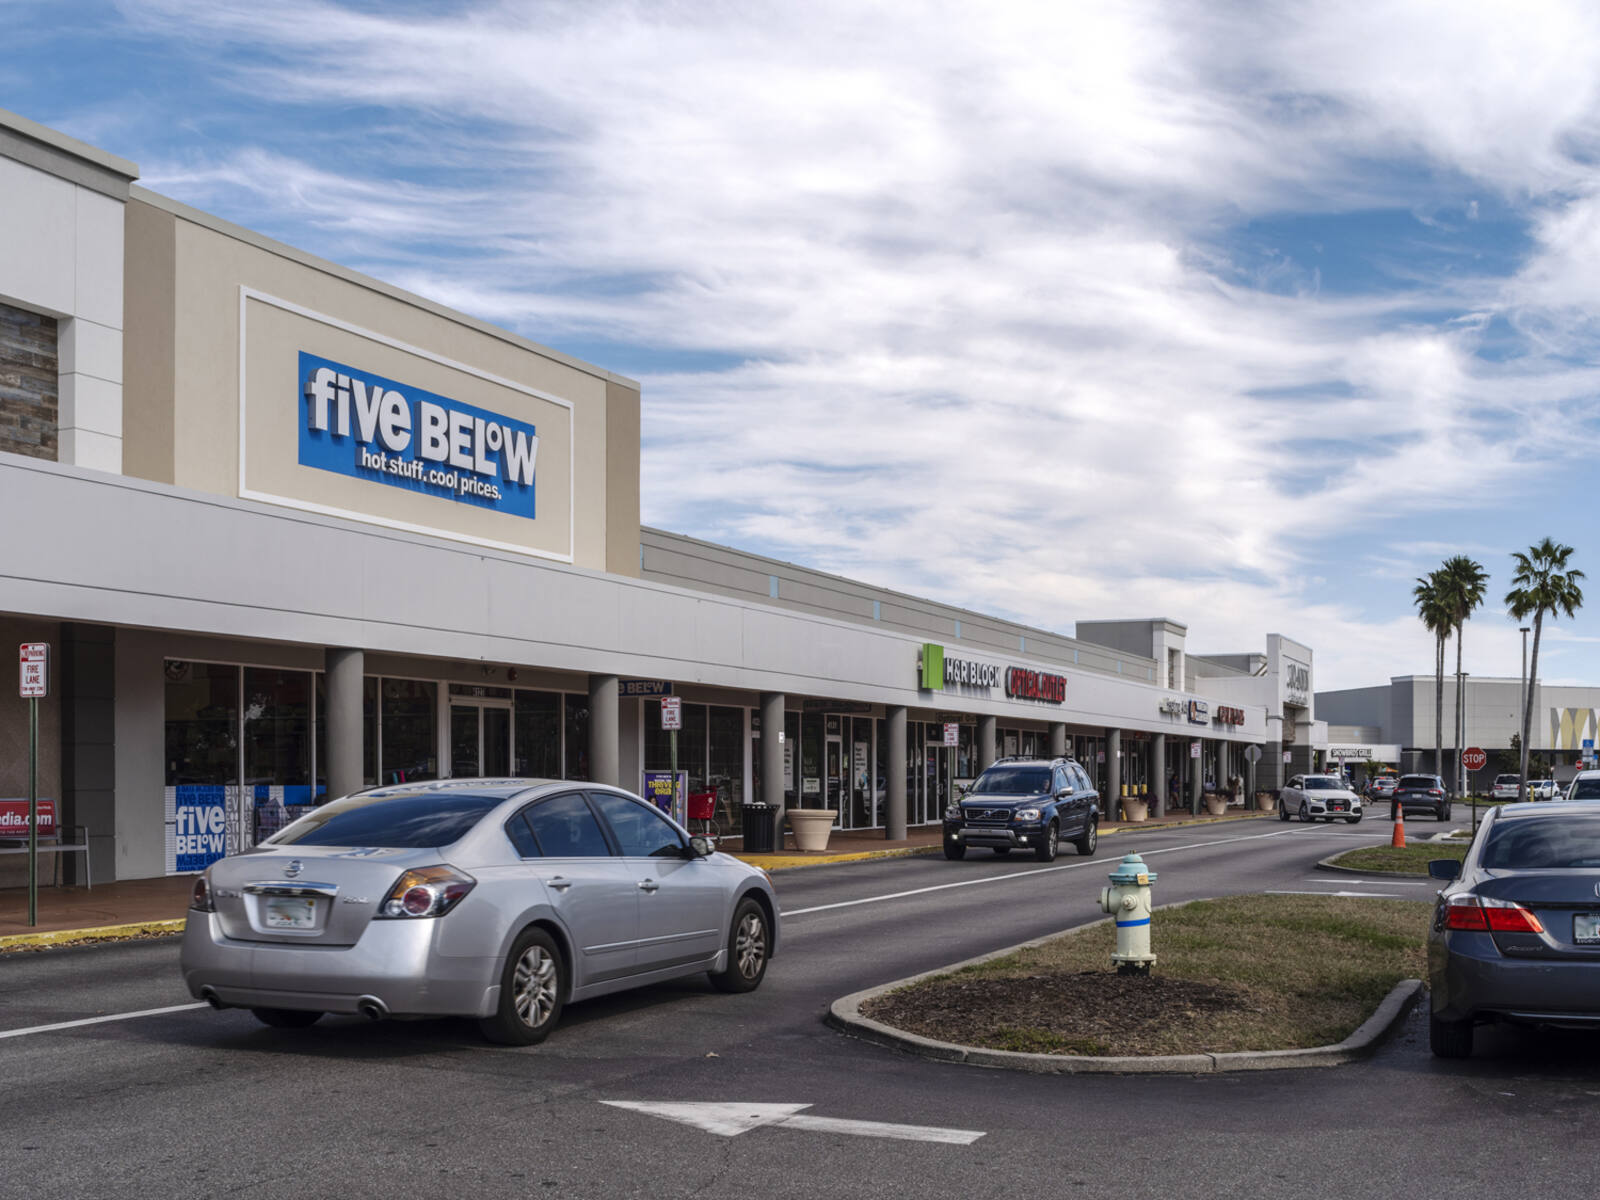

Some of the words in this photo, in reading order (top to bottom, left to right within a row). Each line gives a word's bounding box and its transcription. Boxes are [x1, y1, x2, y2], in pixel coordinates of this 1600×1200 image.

[304, 367, 411, 452] five
[360, 446, 387, 471] hot
[389, 457, 427, 482] stuff.
[430, 471, 458, 489] cool
[460, 476, 502, 500] prices.
[25, 675, 41, 684] LANE
[26, 664, 40, 674] FIRE
[944, 658, 968, 684] H&R
[968, 661, 1002, 688] BLOCK
[1006, 666, 1040, 697] OPTICAL
[1463, 753, 1485, 764] STOP
[226, 796, 253, 812] EVR
[176, 806, 225, 834] five
[176, 834, 225, 855] BELOW
[226, 834, 253, 850] EVR
